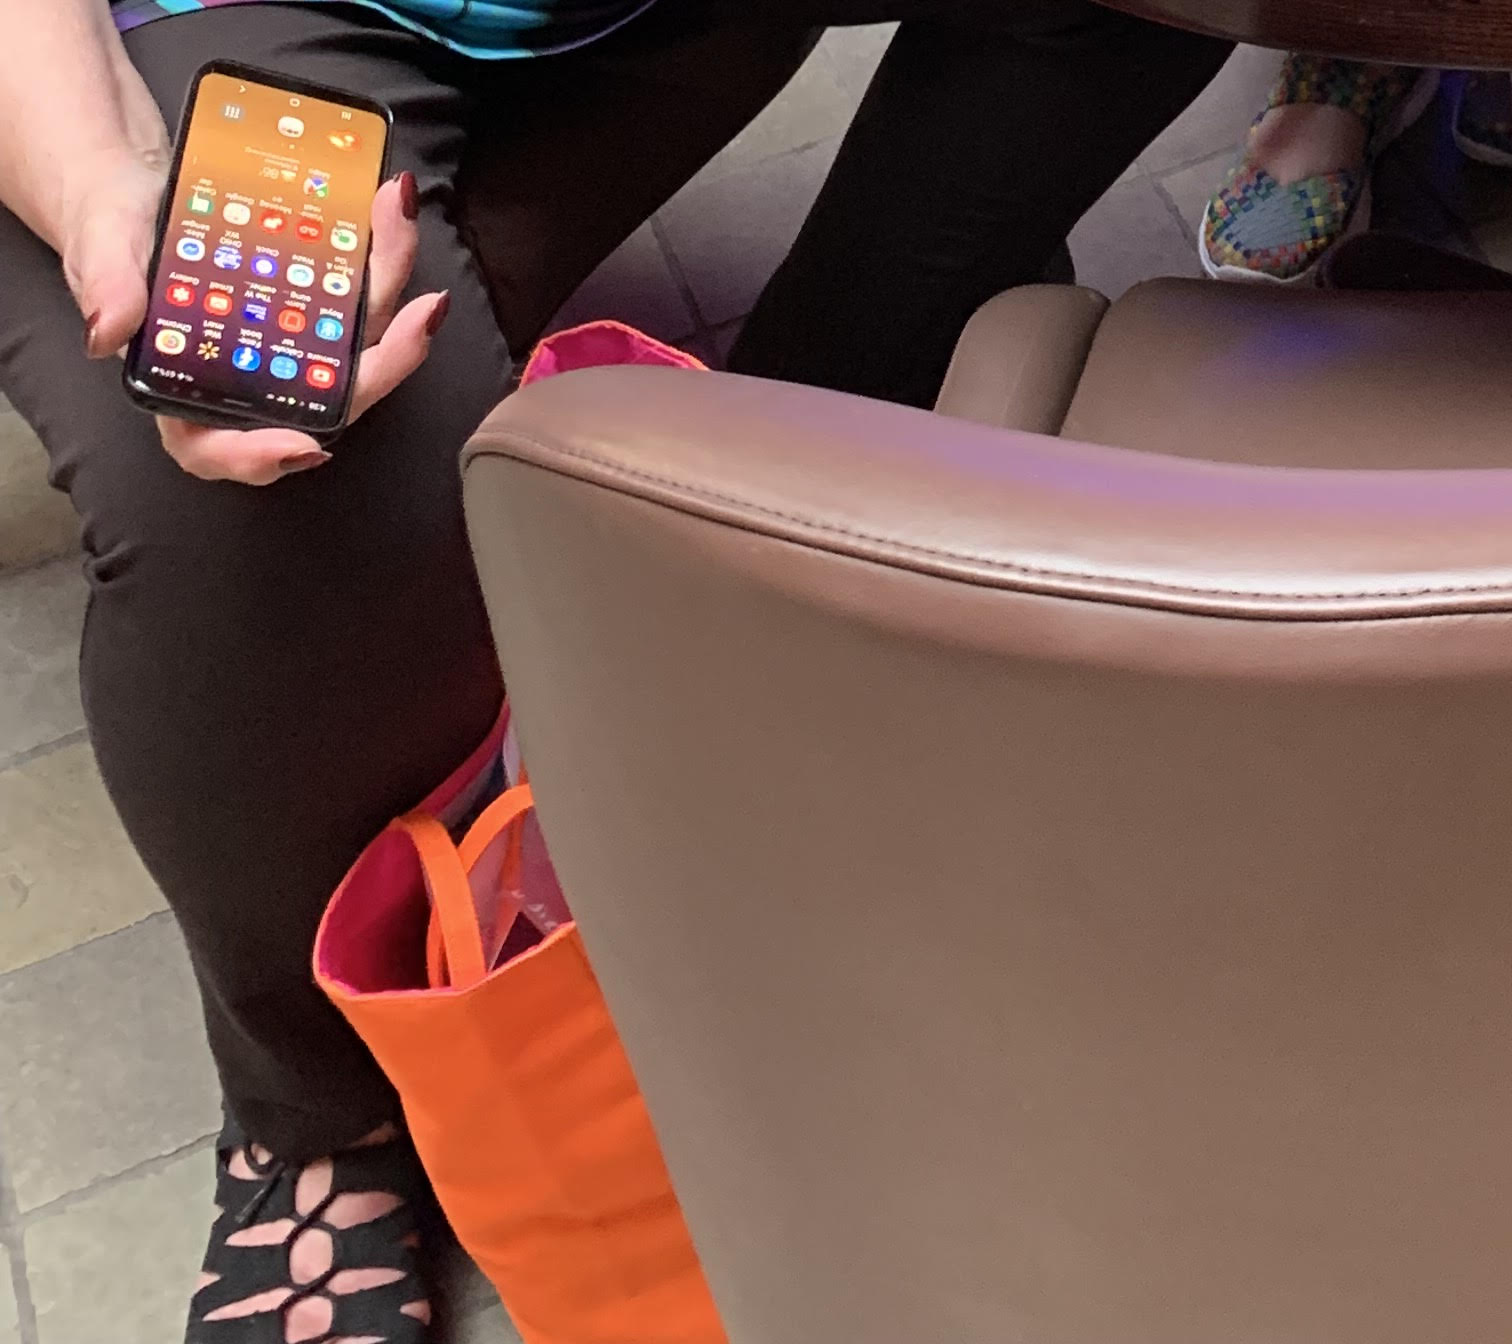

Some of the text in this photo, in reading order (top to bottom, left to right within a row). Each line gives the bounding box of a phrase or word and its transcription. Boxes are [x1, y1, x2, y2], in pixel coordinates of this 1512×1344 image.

[168, 270, 200, 285] Gallery
[208, 280, 234, 293] Email
[318, 305, 344, 319] Royal
[156, 317, 192, 332] Chrome
[239, 327, 263, 340] book
[305, 351, 340, 367] Camera
